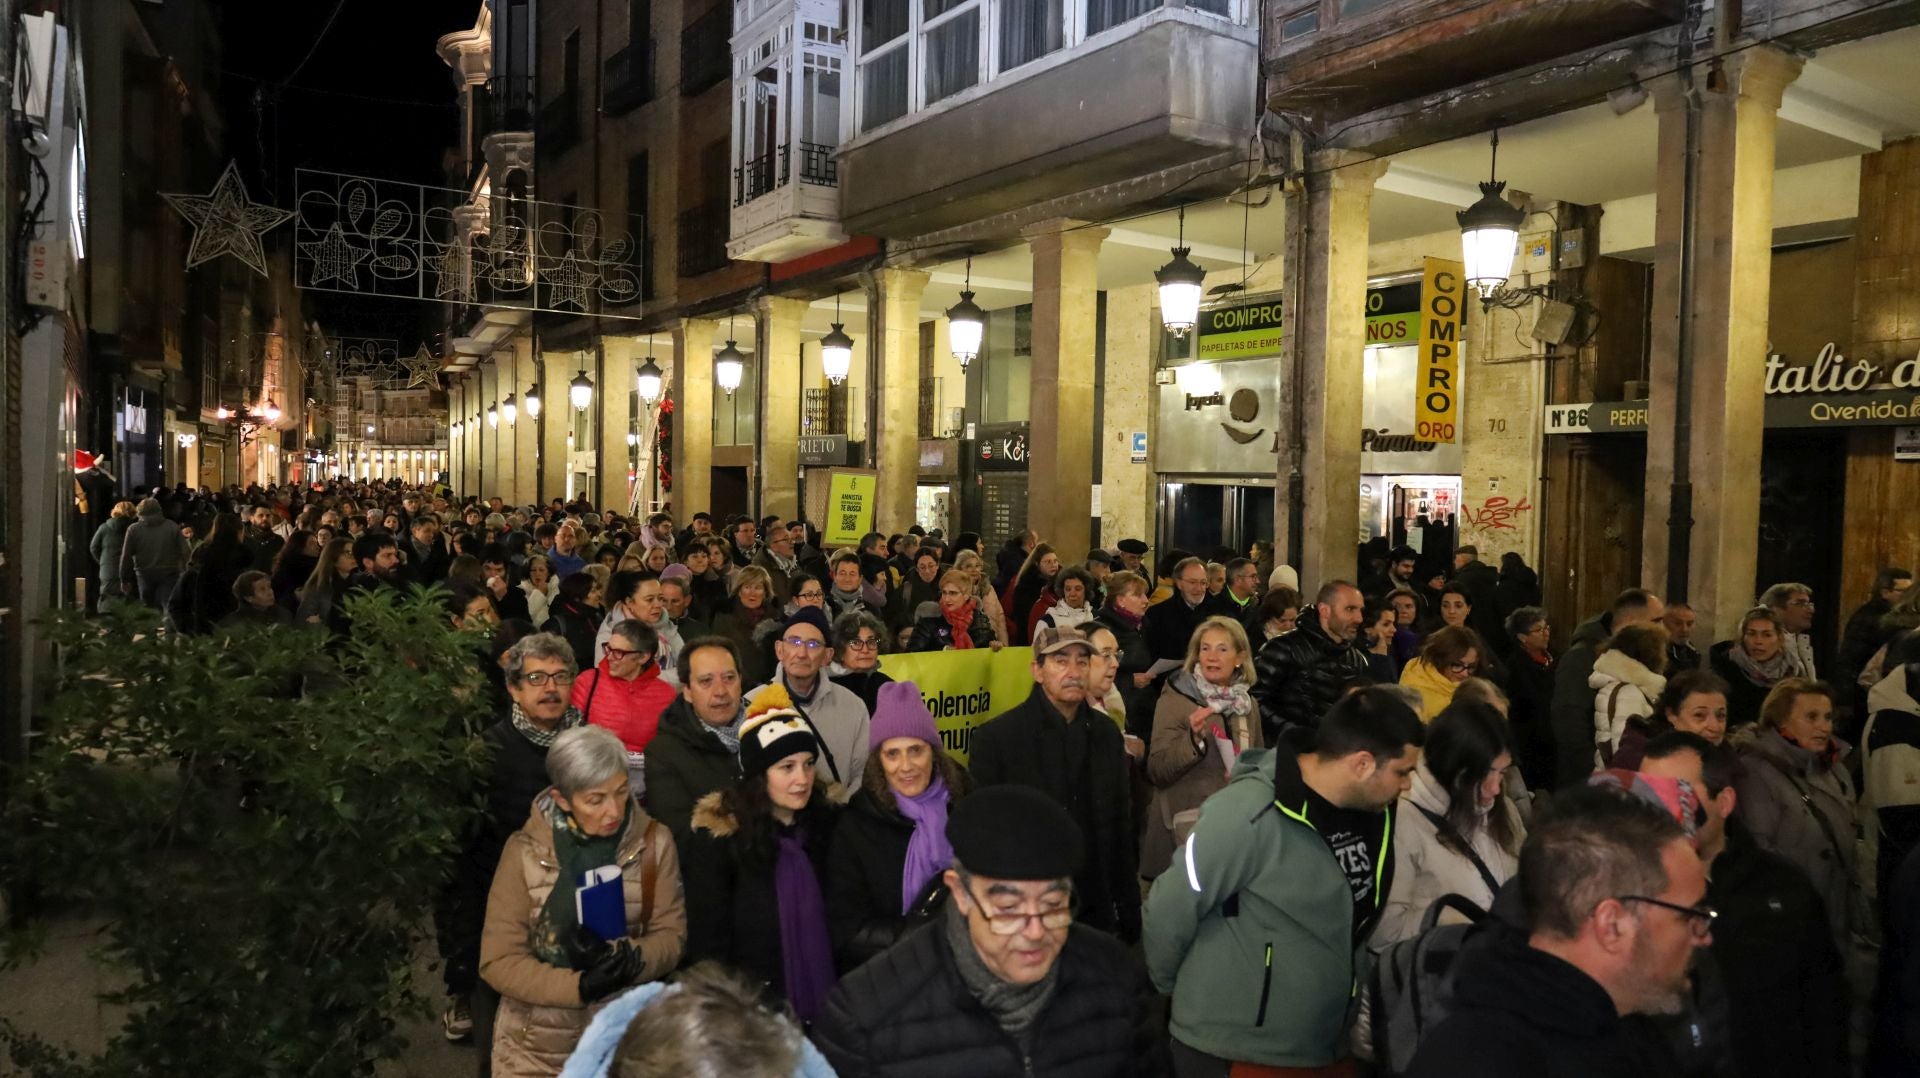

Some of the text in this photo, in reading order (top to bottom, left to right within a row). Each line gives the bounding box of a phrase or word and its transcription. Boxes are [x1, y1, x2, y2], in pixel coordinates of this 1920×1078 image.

[1213, 304, 1283, 329] COMPRO
[1202, 341, 1245, 353] PAPELETAS
[1247, 340, 1258, 349] DE
[1367, 320, 1407, 341] ÑOS
[1426, 272, 1456, 413] COMPRO
[1418, 421, 1455, 440] ORO
[1488, 419, 1506, 432] 70
[798, 439, 835, 453] RIETO
